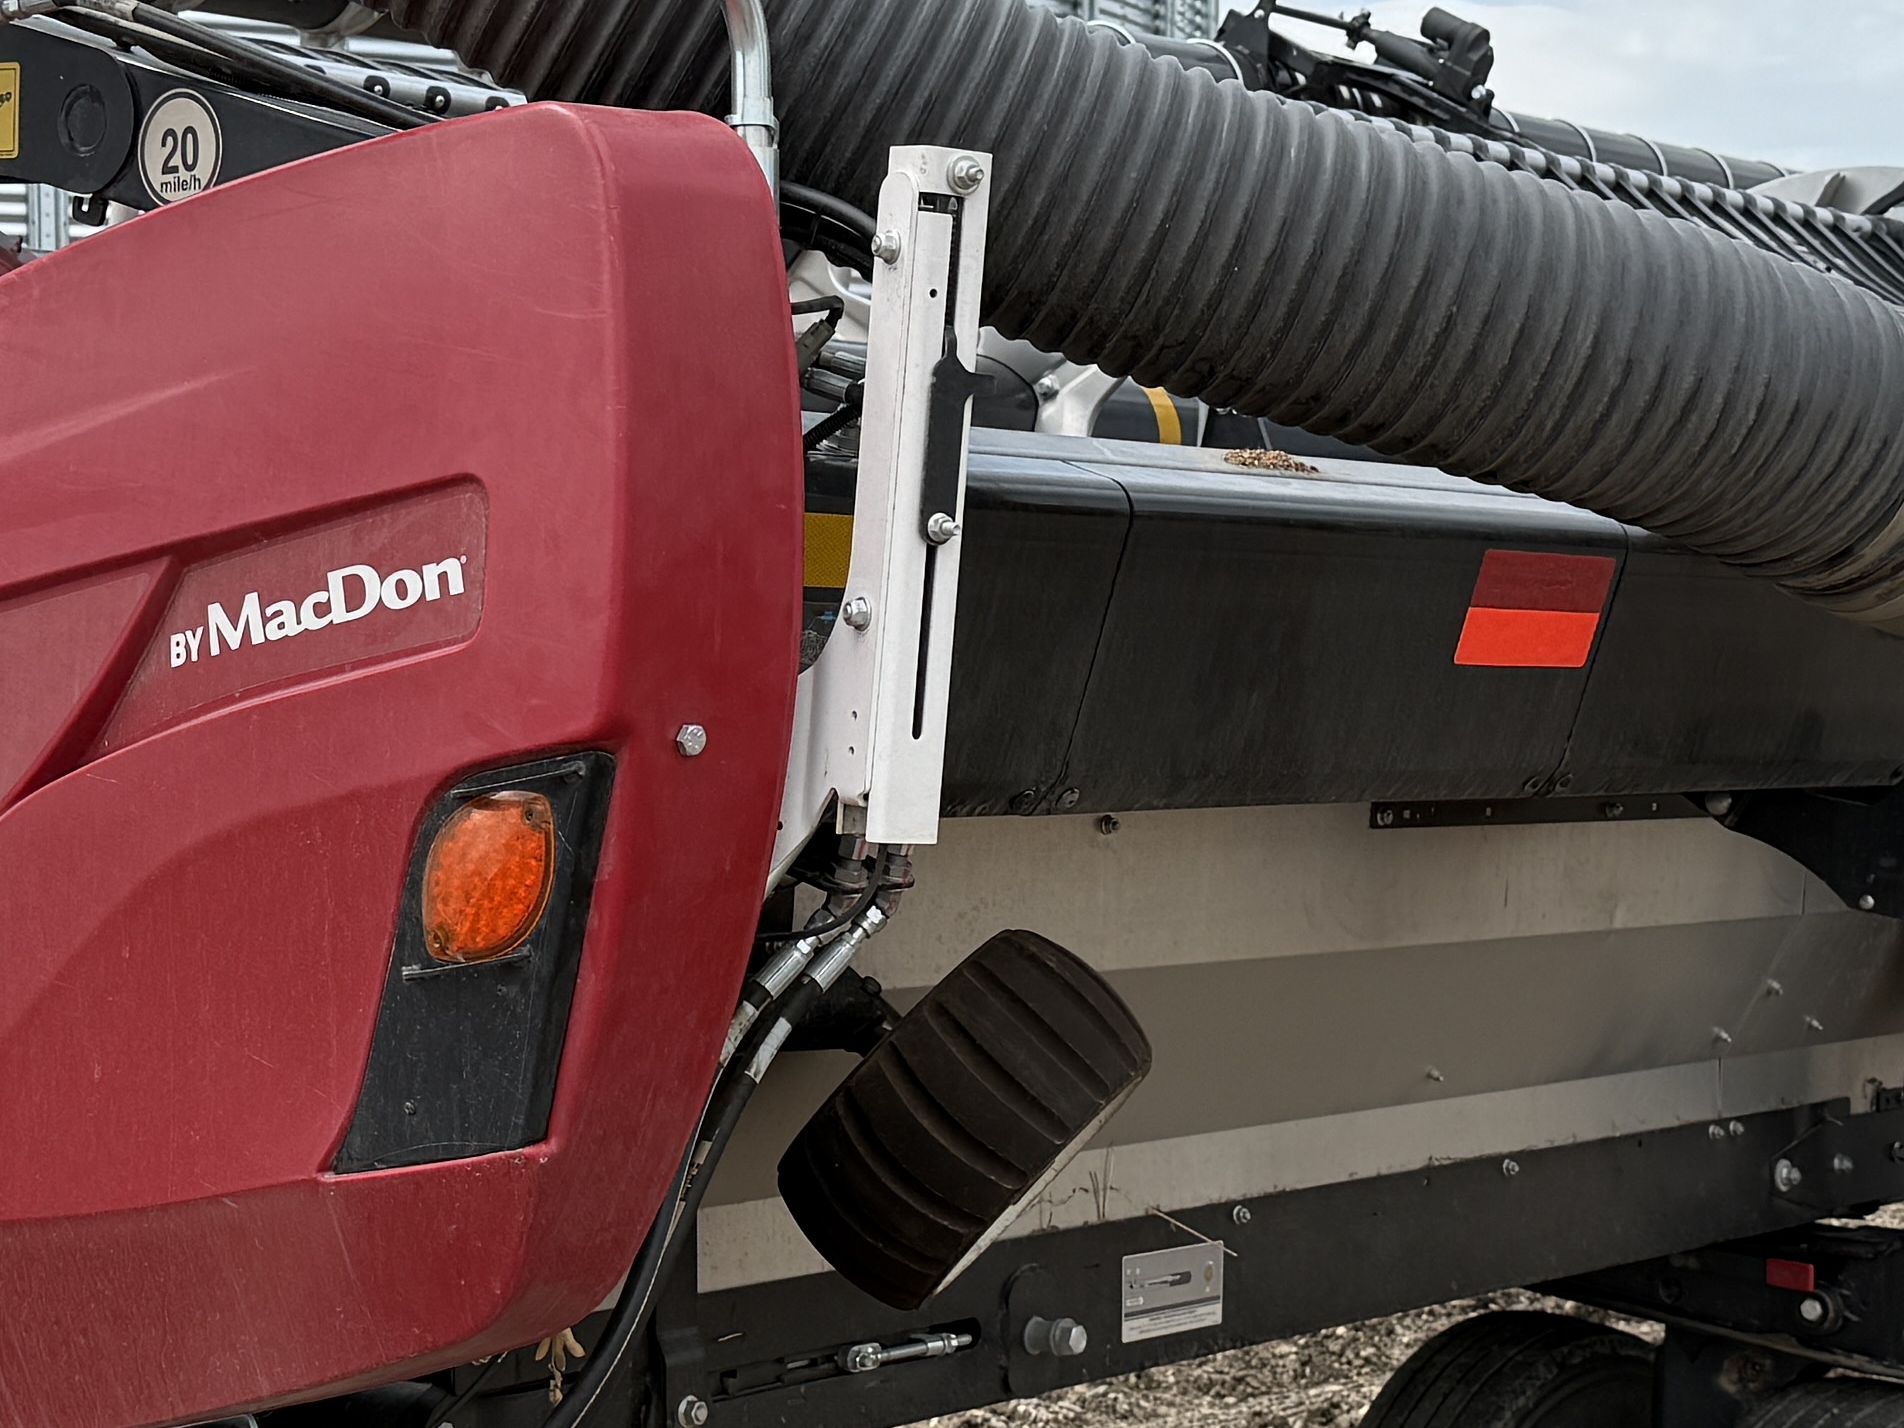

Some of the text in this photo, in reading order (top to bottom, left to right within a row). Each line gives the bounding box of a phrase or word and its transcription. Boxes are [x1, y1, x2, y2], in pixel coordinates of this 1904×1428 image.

[161, 125, 200, 176] 20
[160, 175, 202, 194] mile/h
[170, 556, 467, 668] BY MacDon
